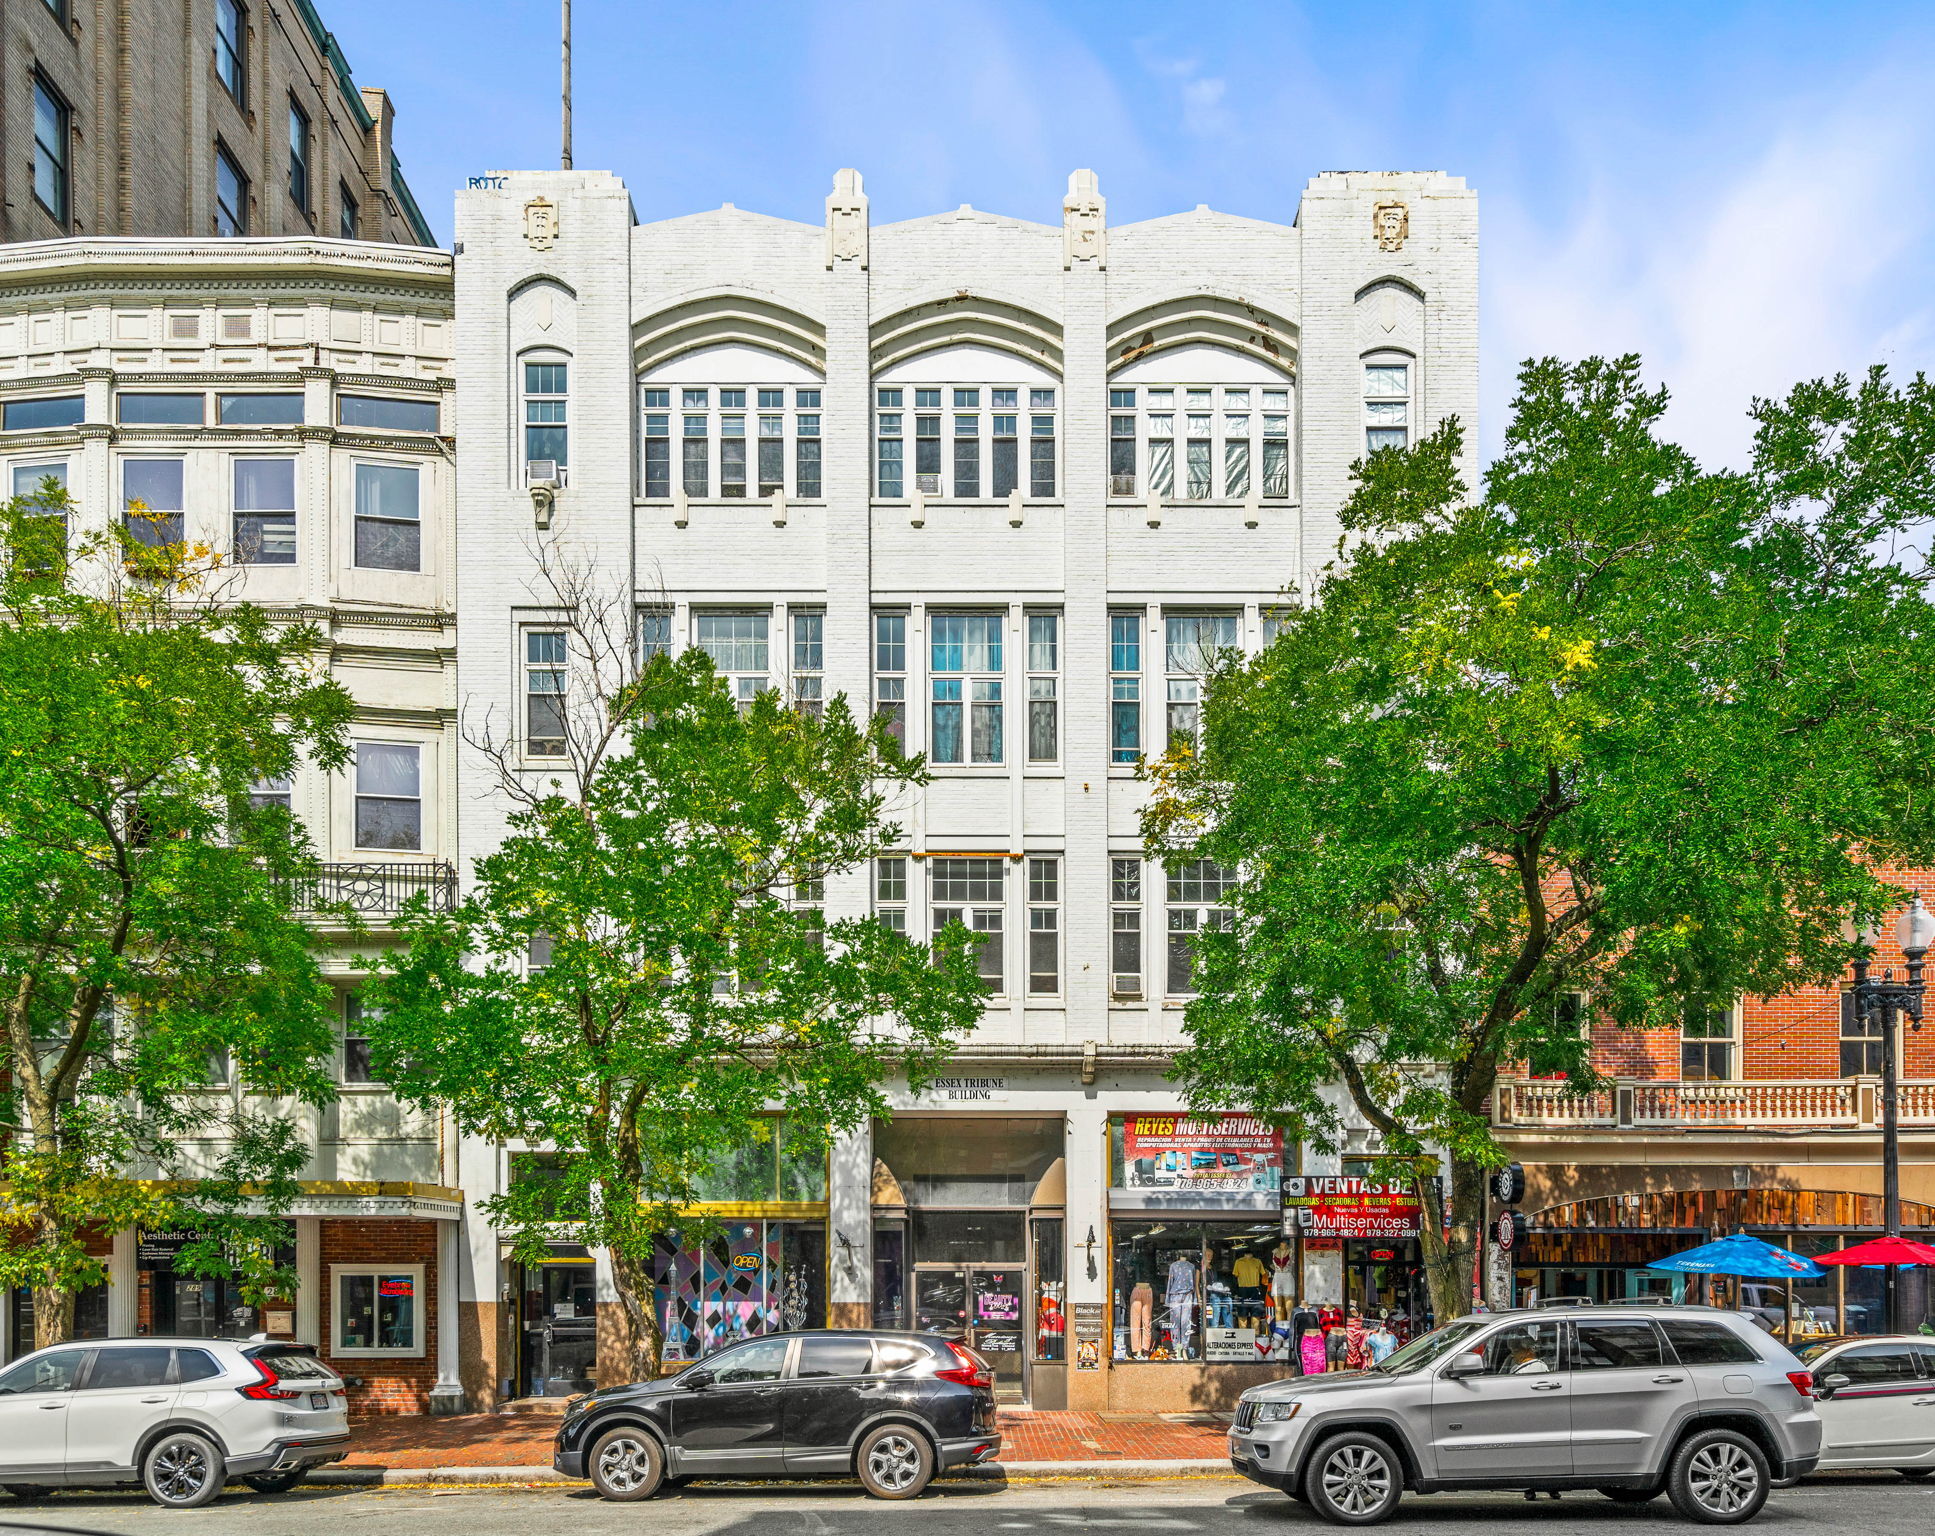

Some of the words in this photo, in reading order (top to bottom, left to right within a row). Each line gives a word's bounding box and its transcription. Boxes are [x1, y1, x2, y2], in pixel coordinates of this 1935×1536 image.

[935, 1078, 962, 1088] ESSEX
[963, 1078, 1004, 1088] TRIBUNE
[948, 1090, 991, 1100] BUILDING
[1134, 1117, 1174, 1136] REYES
[1172, 1178, 1249, 1190] 978-965-4824
[1311, 1177, 1383, 1195] VENTAS
[1285, 1197, 1320, 1206] LAVADORAS
[1325, 1197, 1360, 1206] SECADORAS
[1364, 1197, 1392, 1206] NEVERAS
[1396, 1197, 1419, 1206] ESTUFA
[1313, 1214, 1410, 1229] Multiservices
[140, 1230, 185, 1241] Aesthetic
[1303, 1229, 1358, 1237] 978-965-4824
[1371, 1249, 1395, 1260] OPEN
[733, 1255, 760, 1268] OPEN
[1237, 1342, 1254, 1350] EXPRESS
